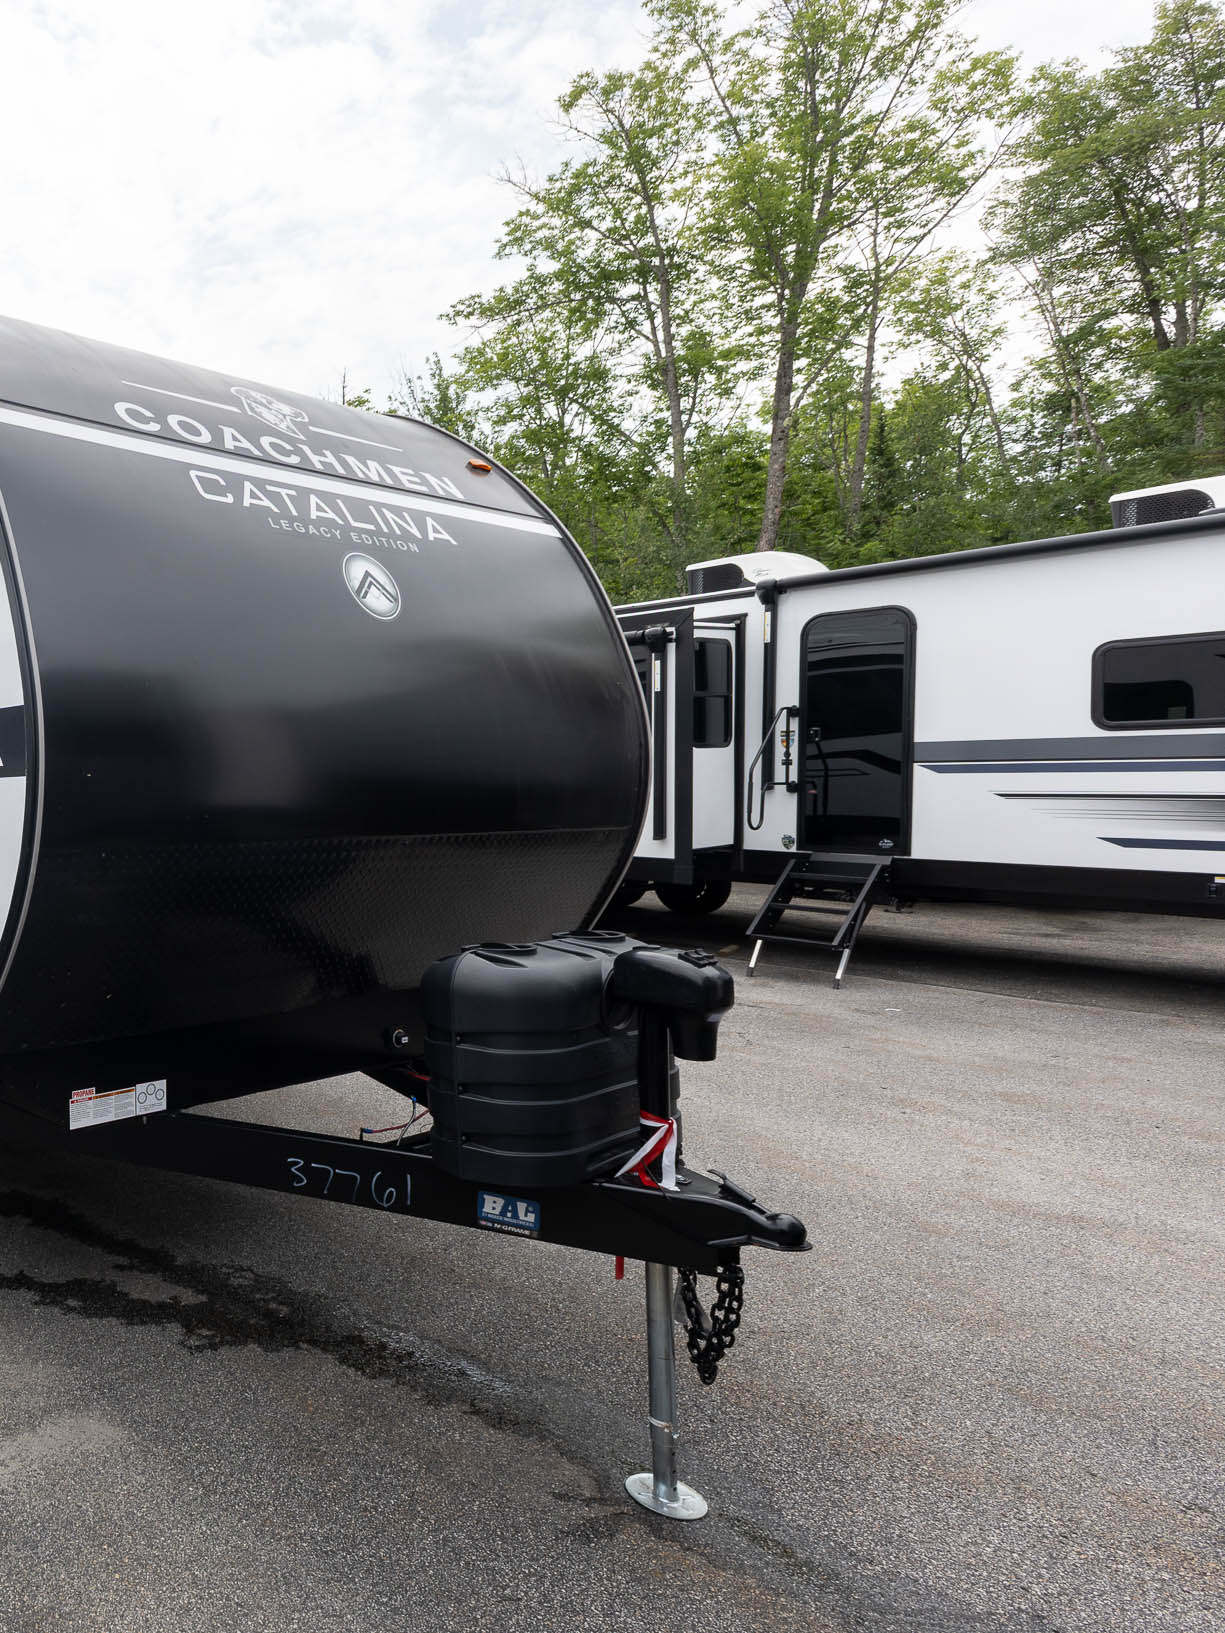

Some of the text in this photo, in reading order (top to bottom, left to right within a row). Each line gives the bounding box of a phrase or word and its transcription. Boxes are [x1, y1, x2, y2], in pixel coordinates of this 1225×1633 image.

[113, 401, 466, 499] COACHMEN
[189, 469, 458, 545] CATALINA
[269, 517, 420, 553] LEGACY EDITION
[72, 1088, 95, 1098] PROPANE
[287, 1157, 411, 1208] 37761
[482, 1194, 536, 1222] BAL
